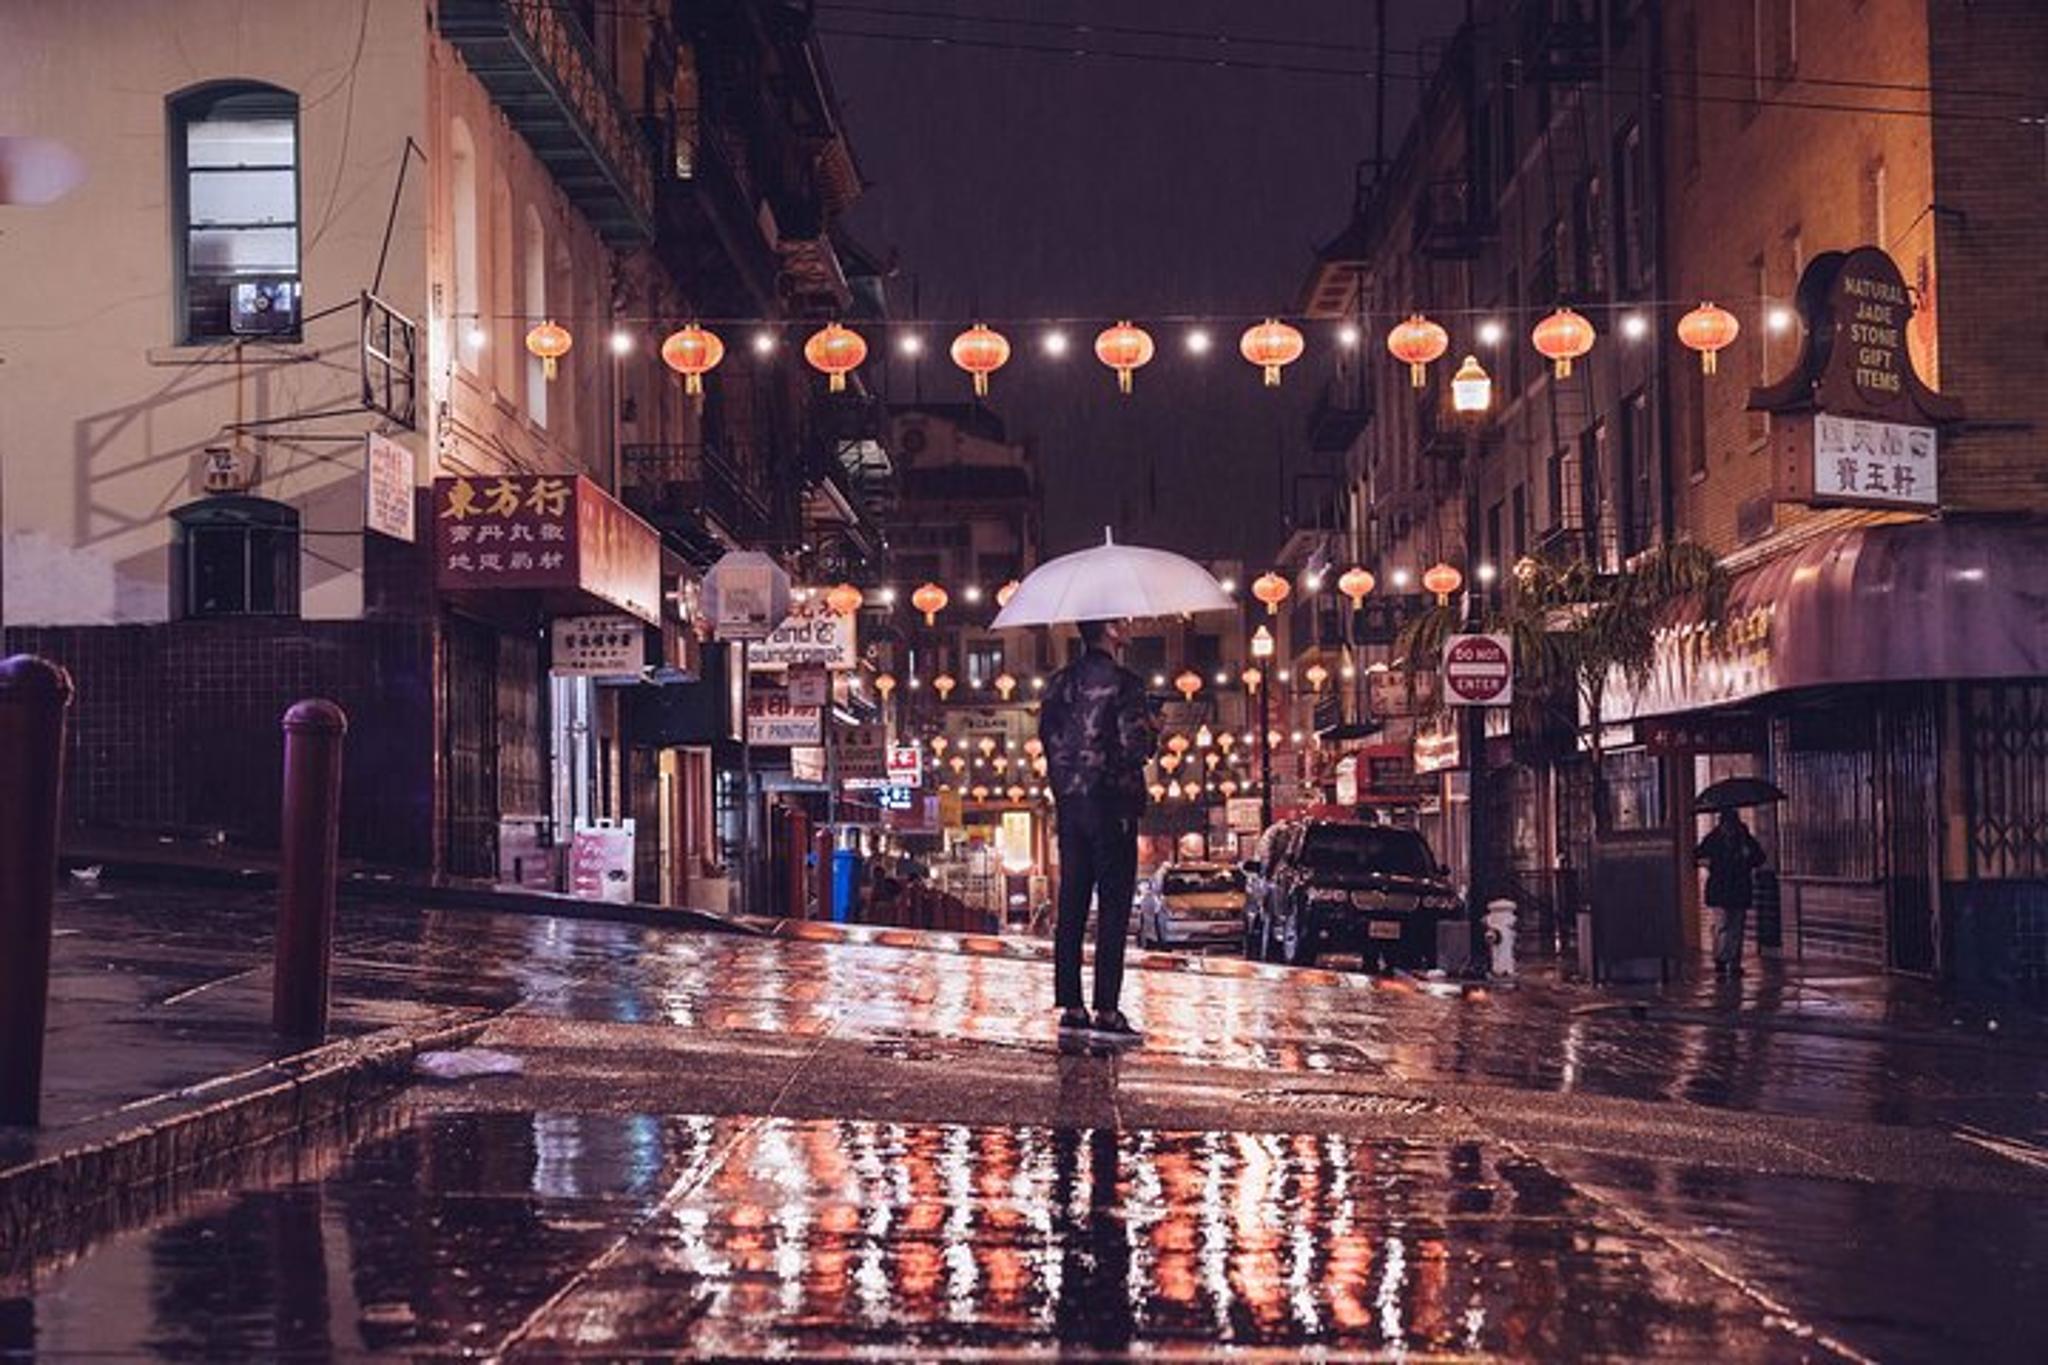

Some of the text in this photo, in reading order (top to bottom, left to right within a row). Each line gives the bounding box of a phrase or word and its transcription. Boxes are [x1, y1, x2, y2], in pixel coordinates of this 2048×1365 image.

[1845, 277, 1905, 304] NATURAL
[1857, 303, 1892, 324] JADE
[1851, 324, 1898, 348] STONE
[1860, 347, 1892, 369] GIFT
[1857, 368, 1900, 391] ITEMS
[440, 478, 571, 520] 東方行
